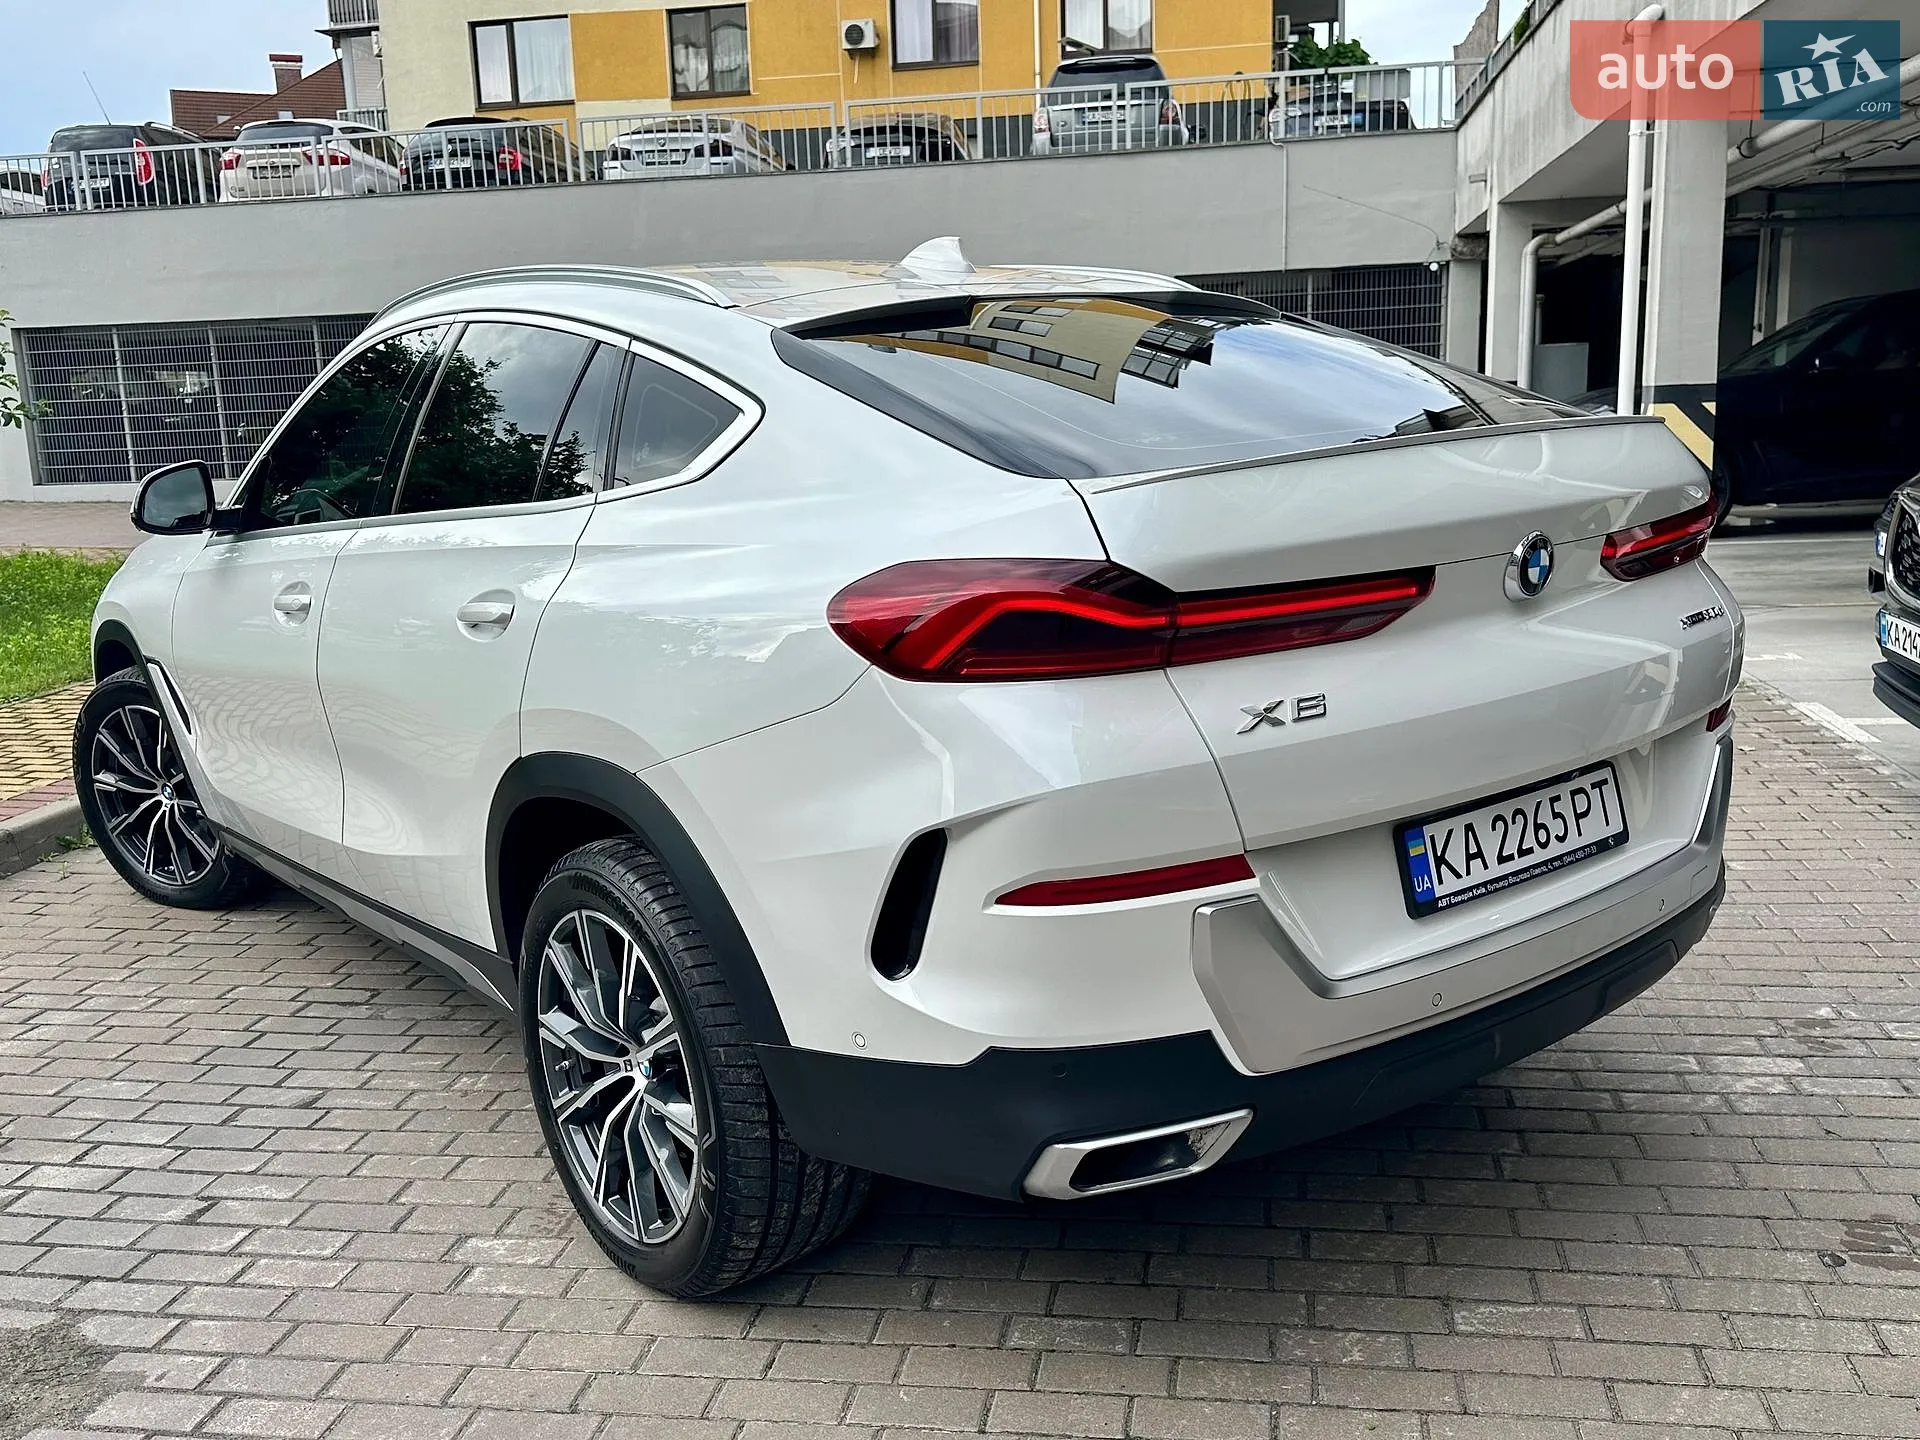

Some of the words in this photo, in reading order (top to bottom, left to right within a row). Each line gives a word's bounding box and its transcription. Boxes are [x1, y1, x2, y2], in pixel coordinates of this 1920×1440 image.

[1886, 619, 1901, 650] KA
[1236, 692, 1327, 735] X6
[1429, 822, 1489, 886] KA
[1414, 874, 1432, 893] UA
